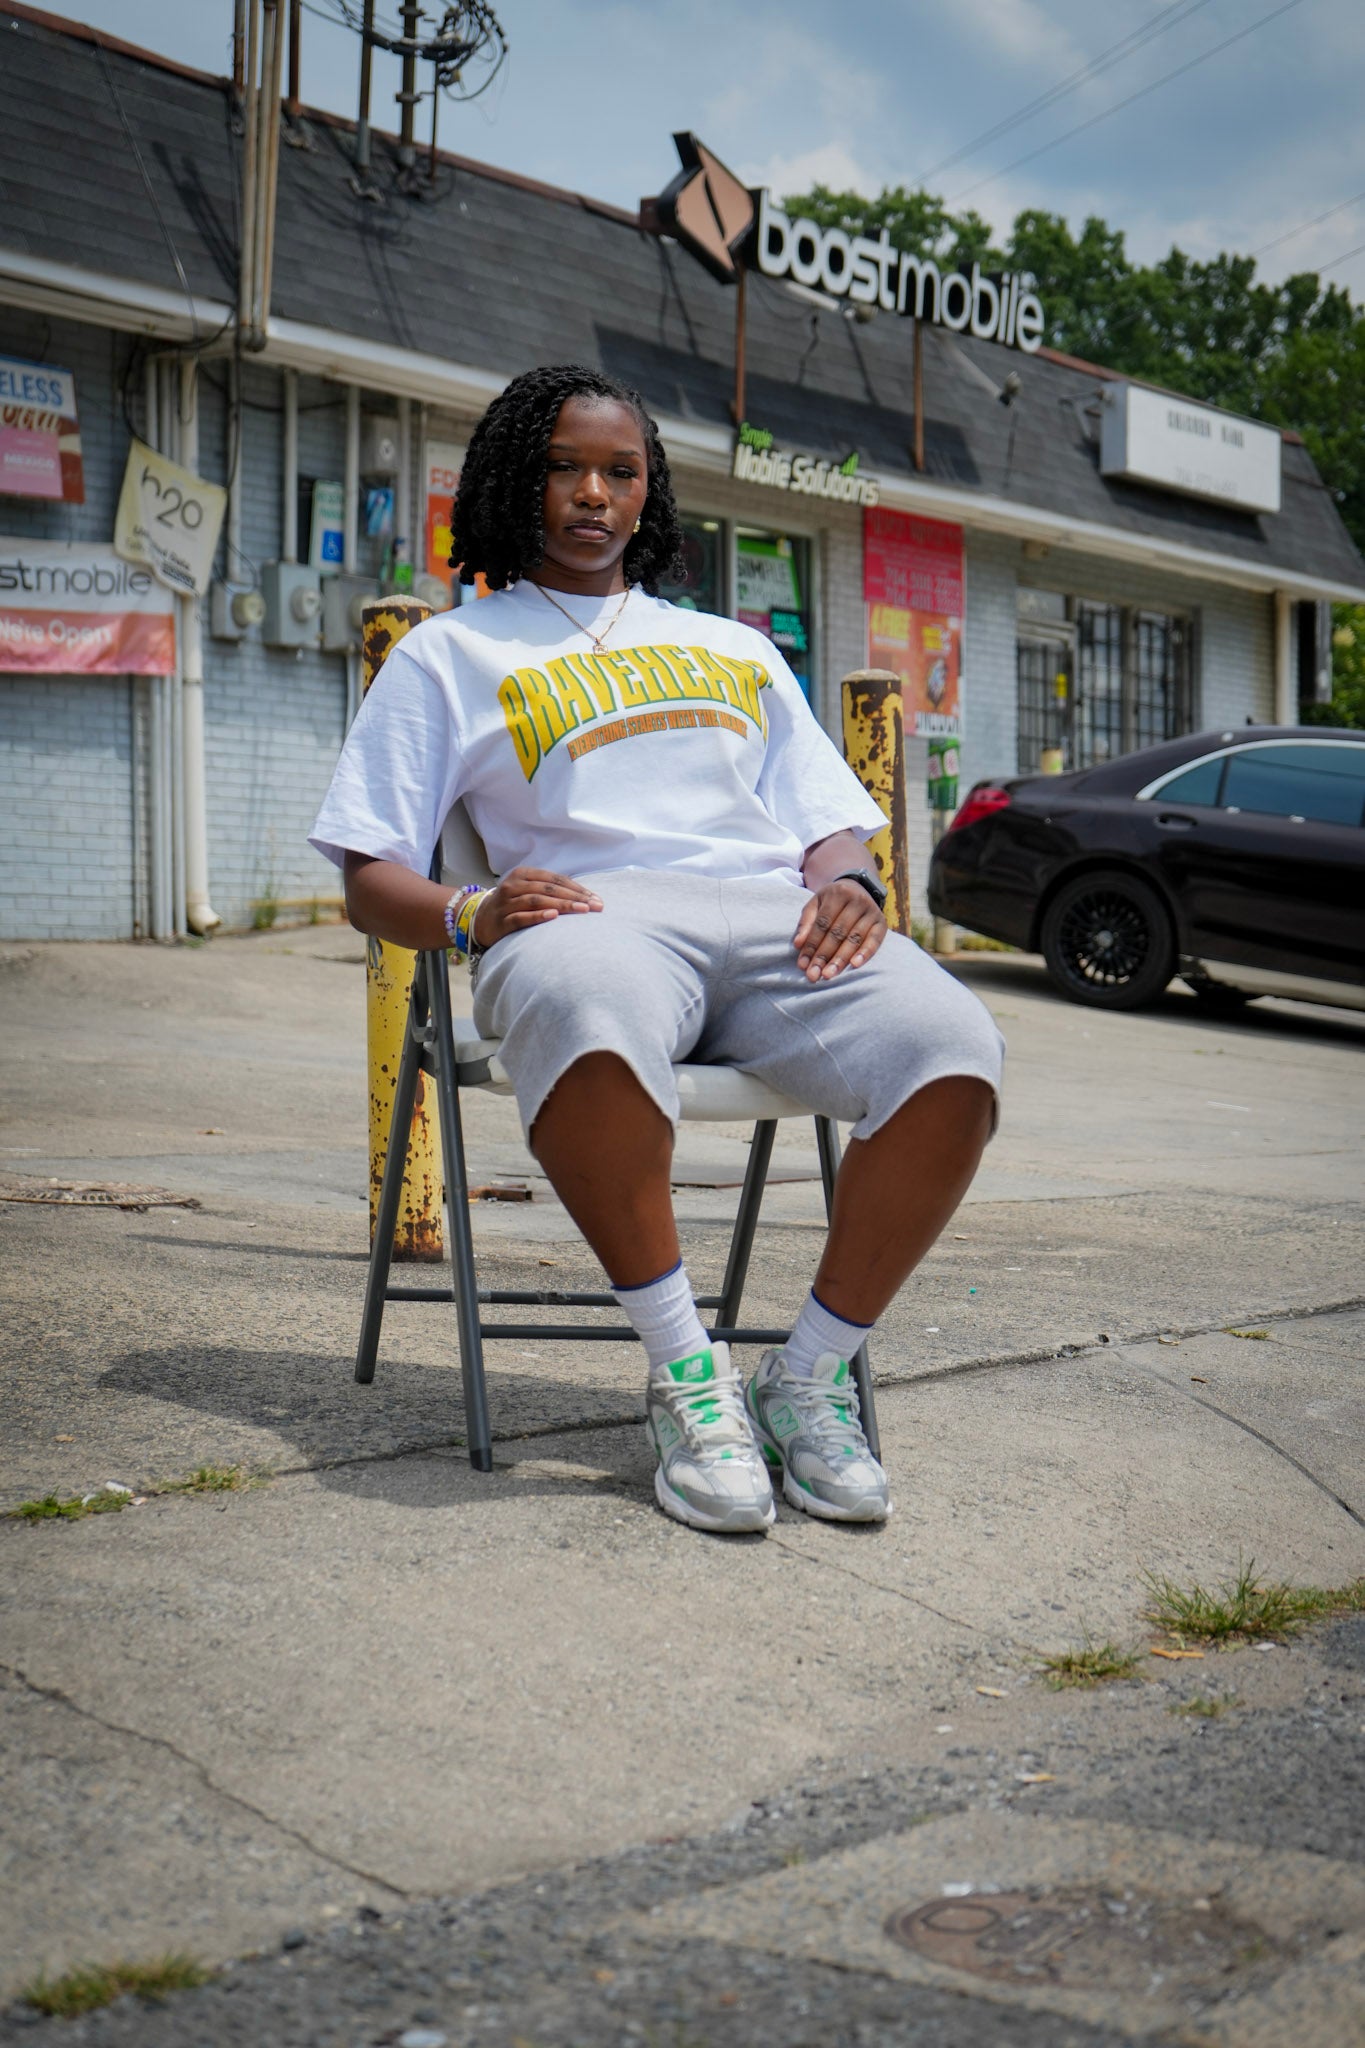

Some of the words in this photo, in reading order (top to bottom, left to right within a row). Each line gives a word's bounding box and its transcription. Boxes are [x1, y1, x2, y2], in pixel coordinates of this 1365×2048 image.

[733, 443, 791, 489] Mobile
[789, 456, 879, 507] Solutions
[50, 618, 113, 648] Open
[566, 718, 628, 763] EVERYTHING
[626, 711, 668, 738] STARTS
[666, 709, 699, 730] WITH
[695, 708, 721, 728] THE
